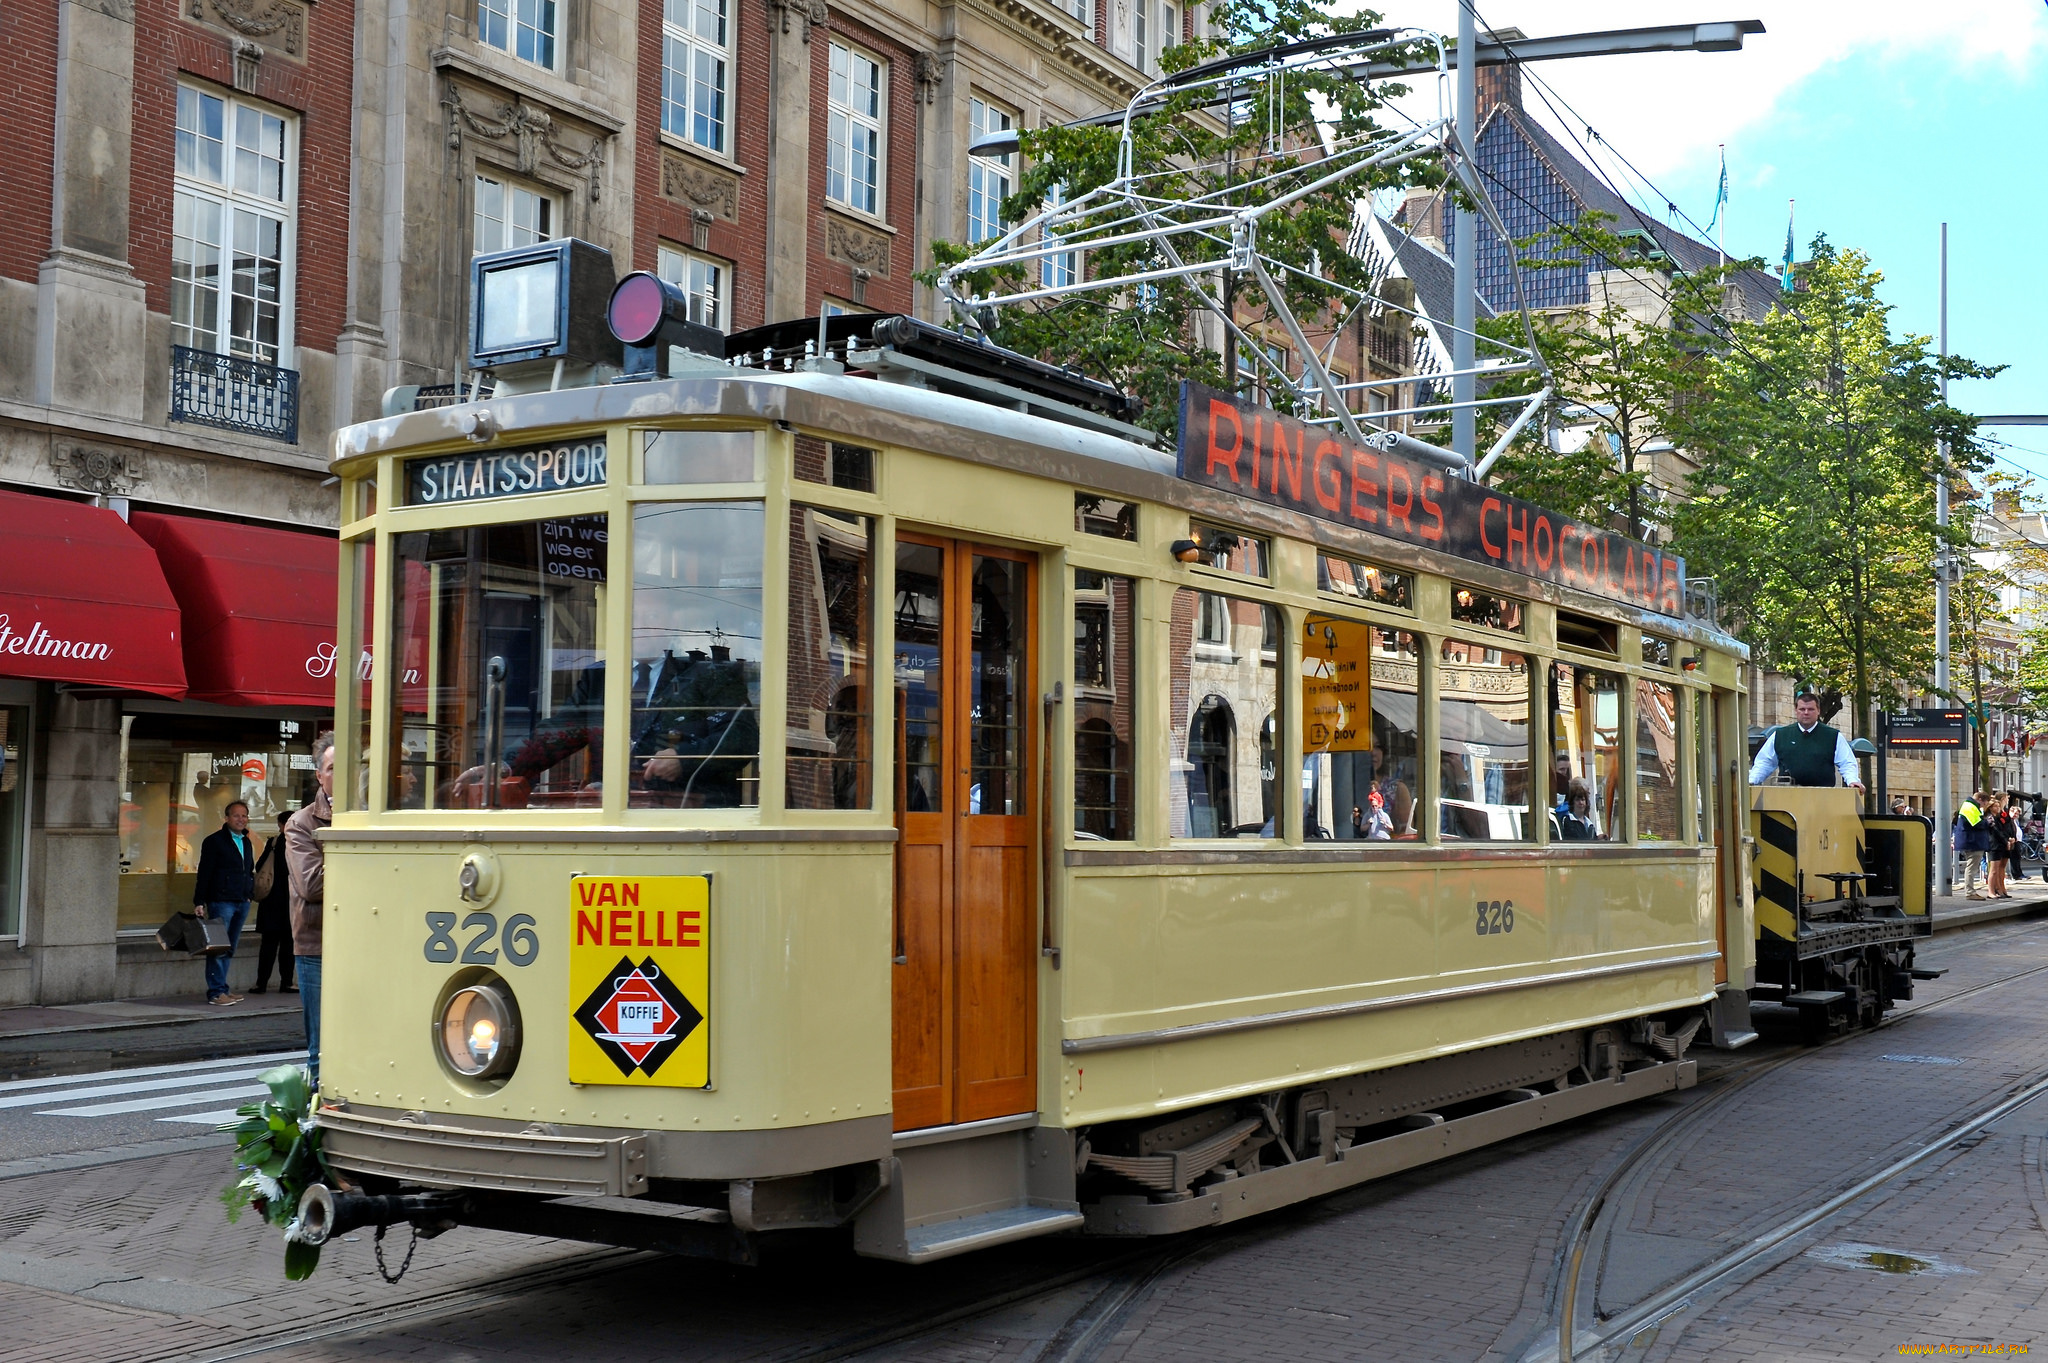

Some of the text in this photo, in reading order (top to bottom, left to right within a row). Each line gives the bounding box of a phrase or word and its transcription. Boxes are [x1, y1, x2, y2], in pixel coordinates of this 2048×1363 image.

[421, 442, 606, 503] STAATSSPOOR
[1206, 398, 1679, 610] RINGERS CHOCOLADE
[544, 520, 573, 540] zijn
[546, 542, 594, 560] weer
[548, 561, 605, 580] open.
[577, 882, 640, 907] VAN
[577, 910, 701, 947] NELLE
[1476, 899, 1514, 935] 826
[423, 910, 540, 967] 826
[620, 1005, 660, 1021] KOFFIE
